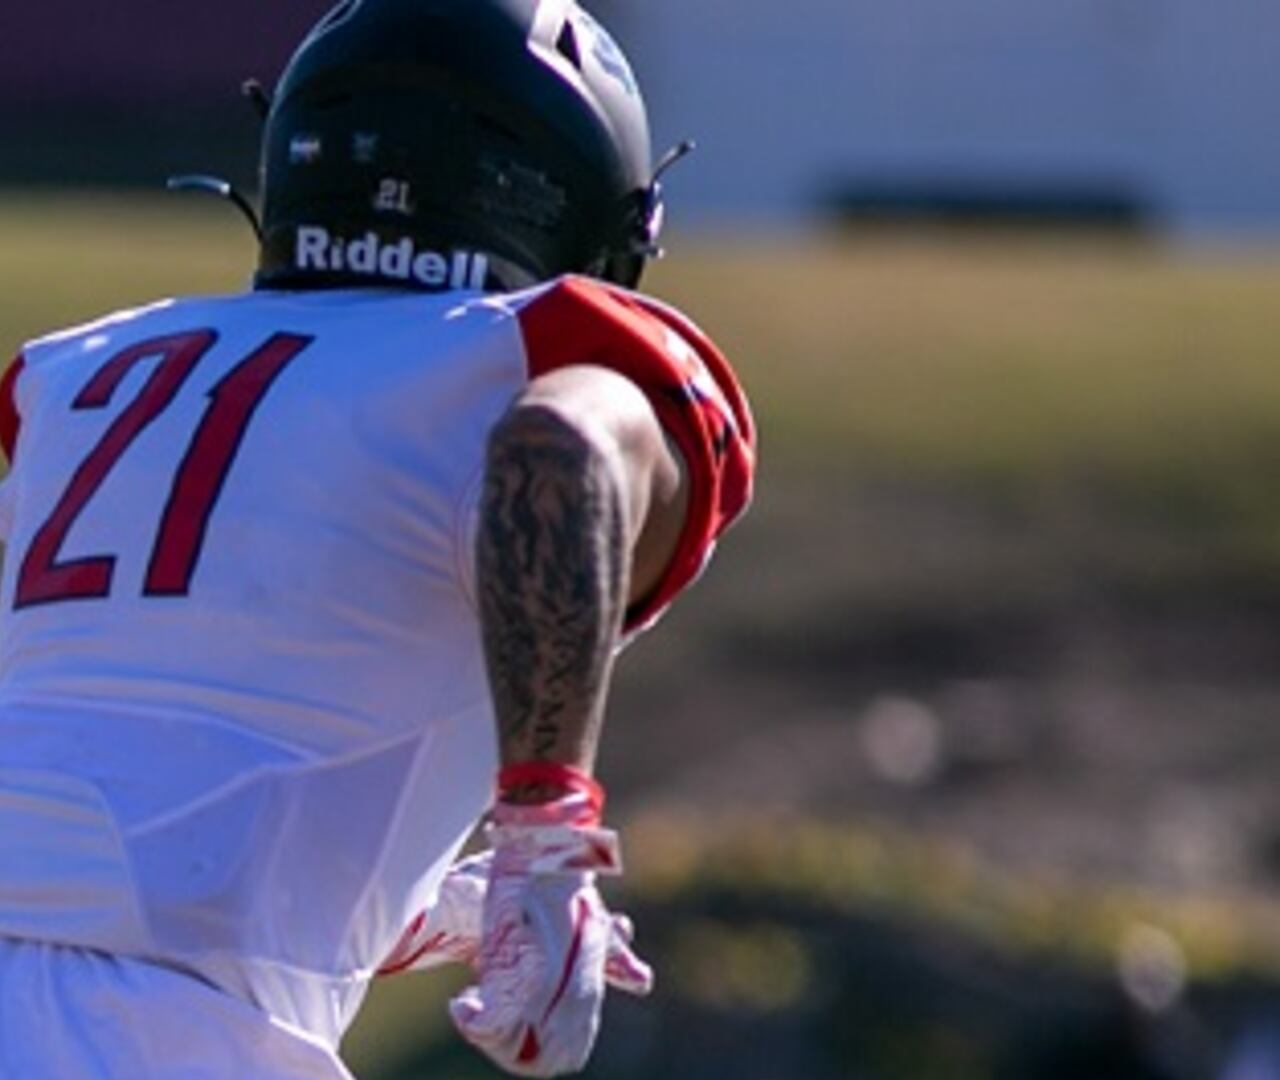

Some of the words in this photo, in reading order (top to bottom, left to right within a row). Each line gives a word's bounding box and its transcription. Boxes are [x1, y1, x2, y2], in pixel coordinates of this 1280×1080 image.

[372, 177, 413, 214] 21
[296, 226, 488, 290] Riddell
[11, 326, 317, 611] 21
